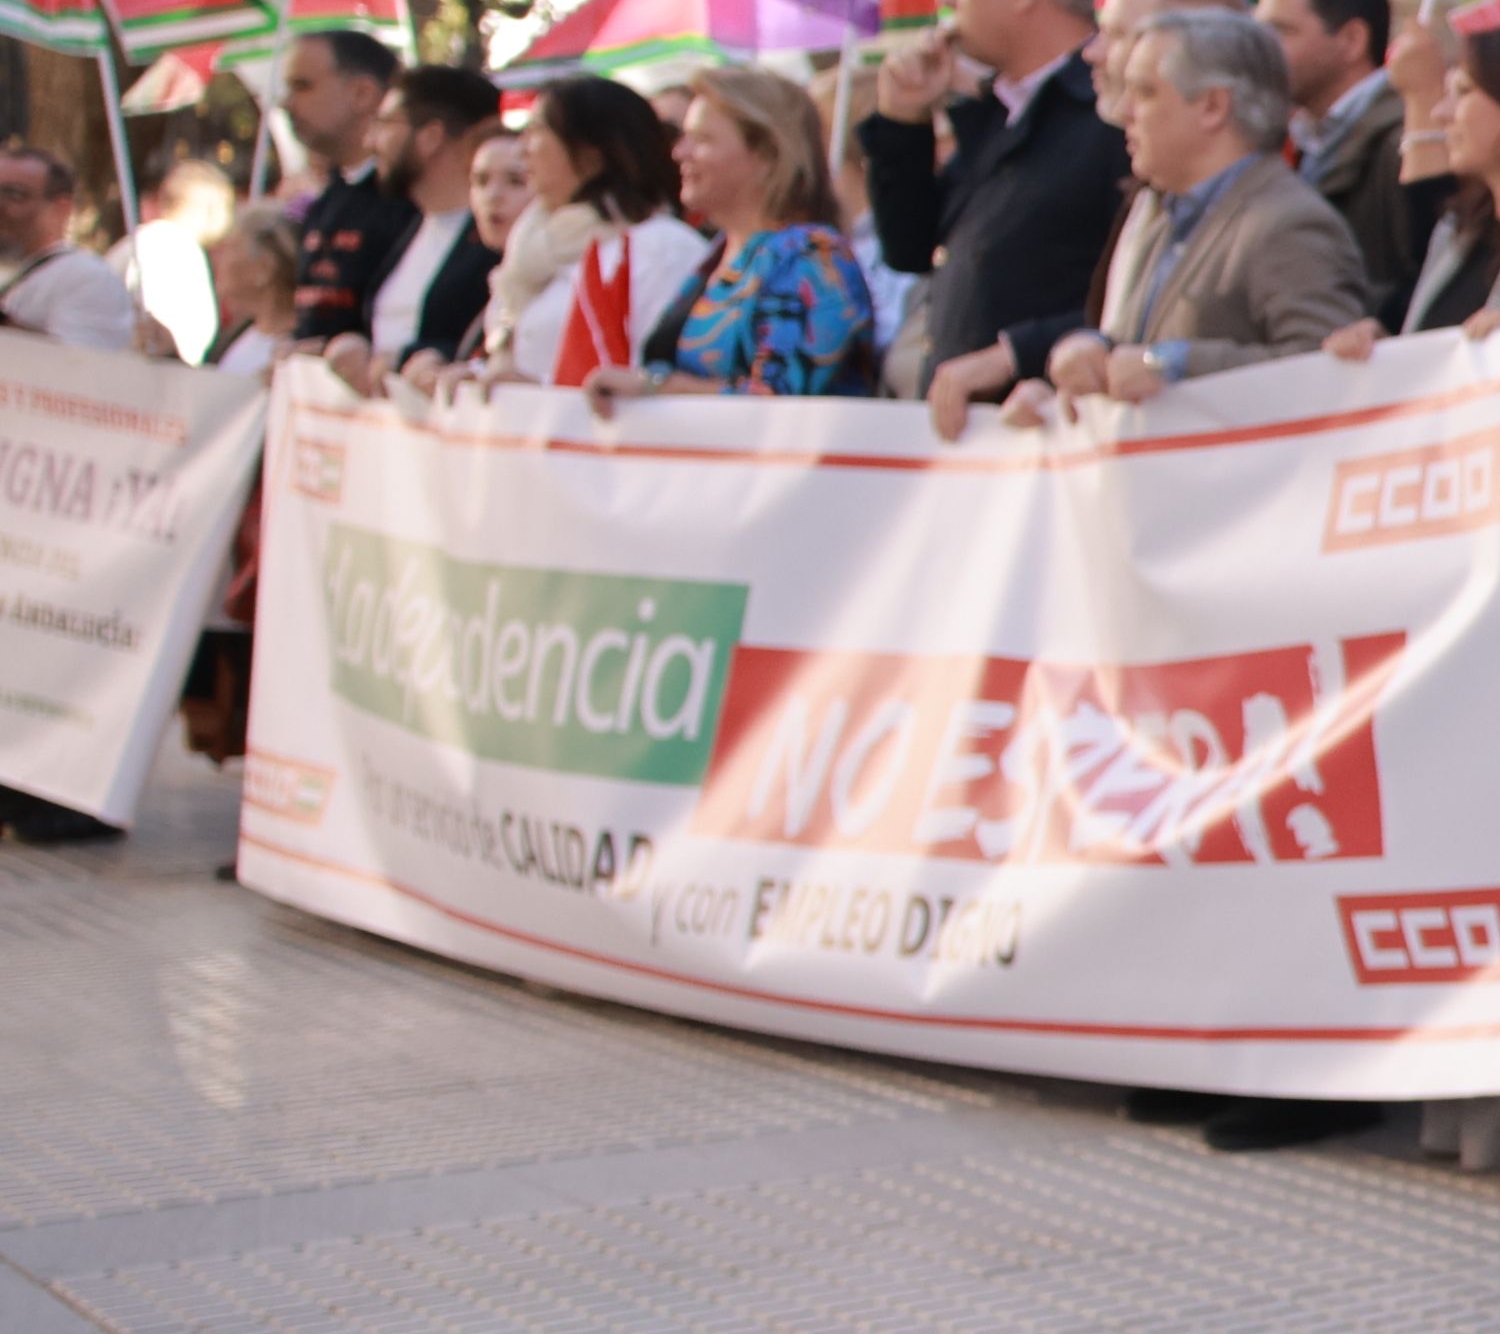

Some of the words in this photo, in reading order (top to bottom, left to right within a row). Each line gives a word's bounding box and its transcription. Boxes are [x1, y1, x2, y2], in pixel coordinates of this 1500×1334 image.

[1336, 448, 1493, 535] CCOO
[747, 697, 913, 841] NO
[500, 809, 656, 903] CALIDAD
